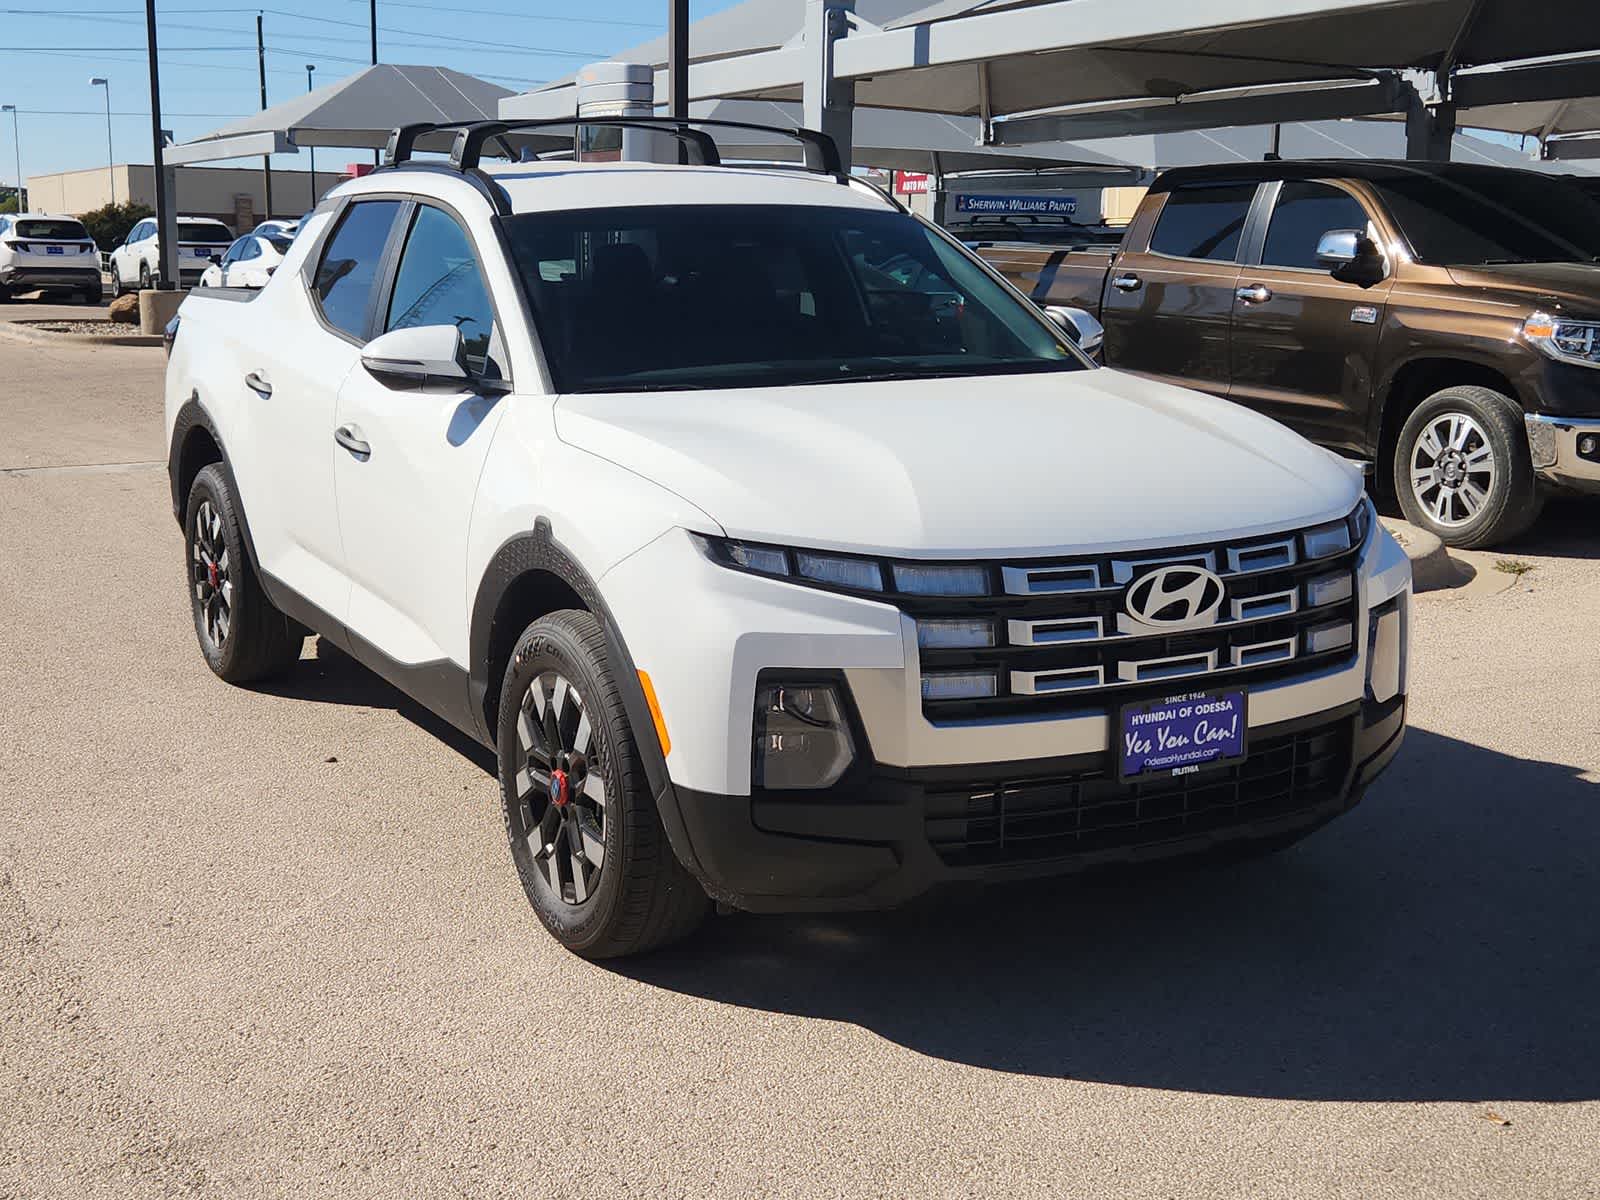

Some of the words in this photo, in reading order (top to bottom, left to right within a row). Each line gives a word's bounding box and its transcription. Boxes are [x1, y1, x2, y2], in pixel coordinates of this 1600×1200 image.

[1048, 200, 1076, 212] PAINTS
[1165, 694, 1187, 705] SINCE
[1132, 710, 1176, 725] HYUNDAI
[1179, 706, 1192, 718] OF
[1195, 701, 1232, 714] ODESSA
[1125, 731, 1152, 756] Yes
[1157, 726, 1189, 750] You
[1194, 715, 1237, 744] Can!
[1144, 748, 1219, 765] OdessaHyundai.com
